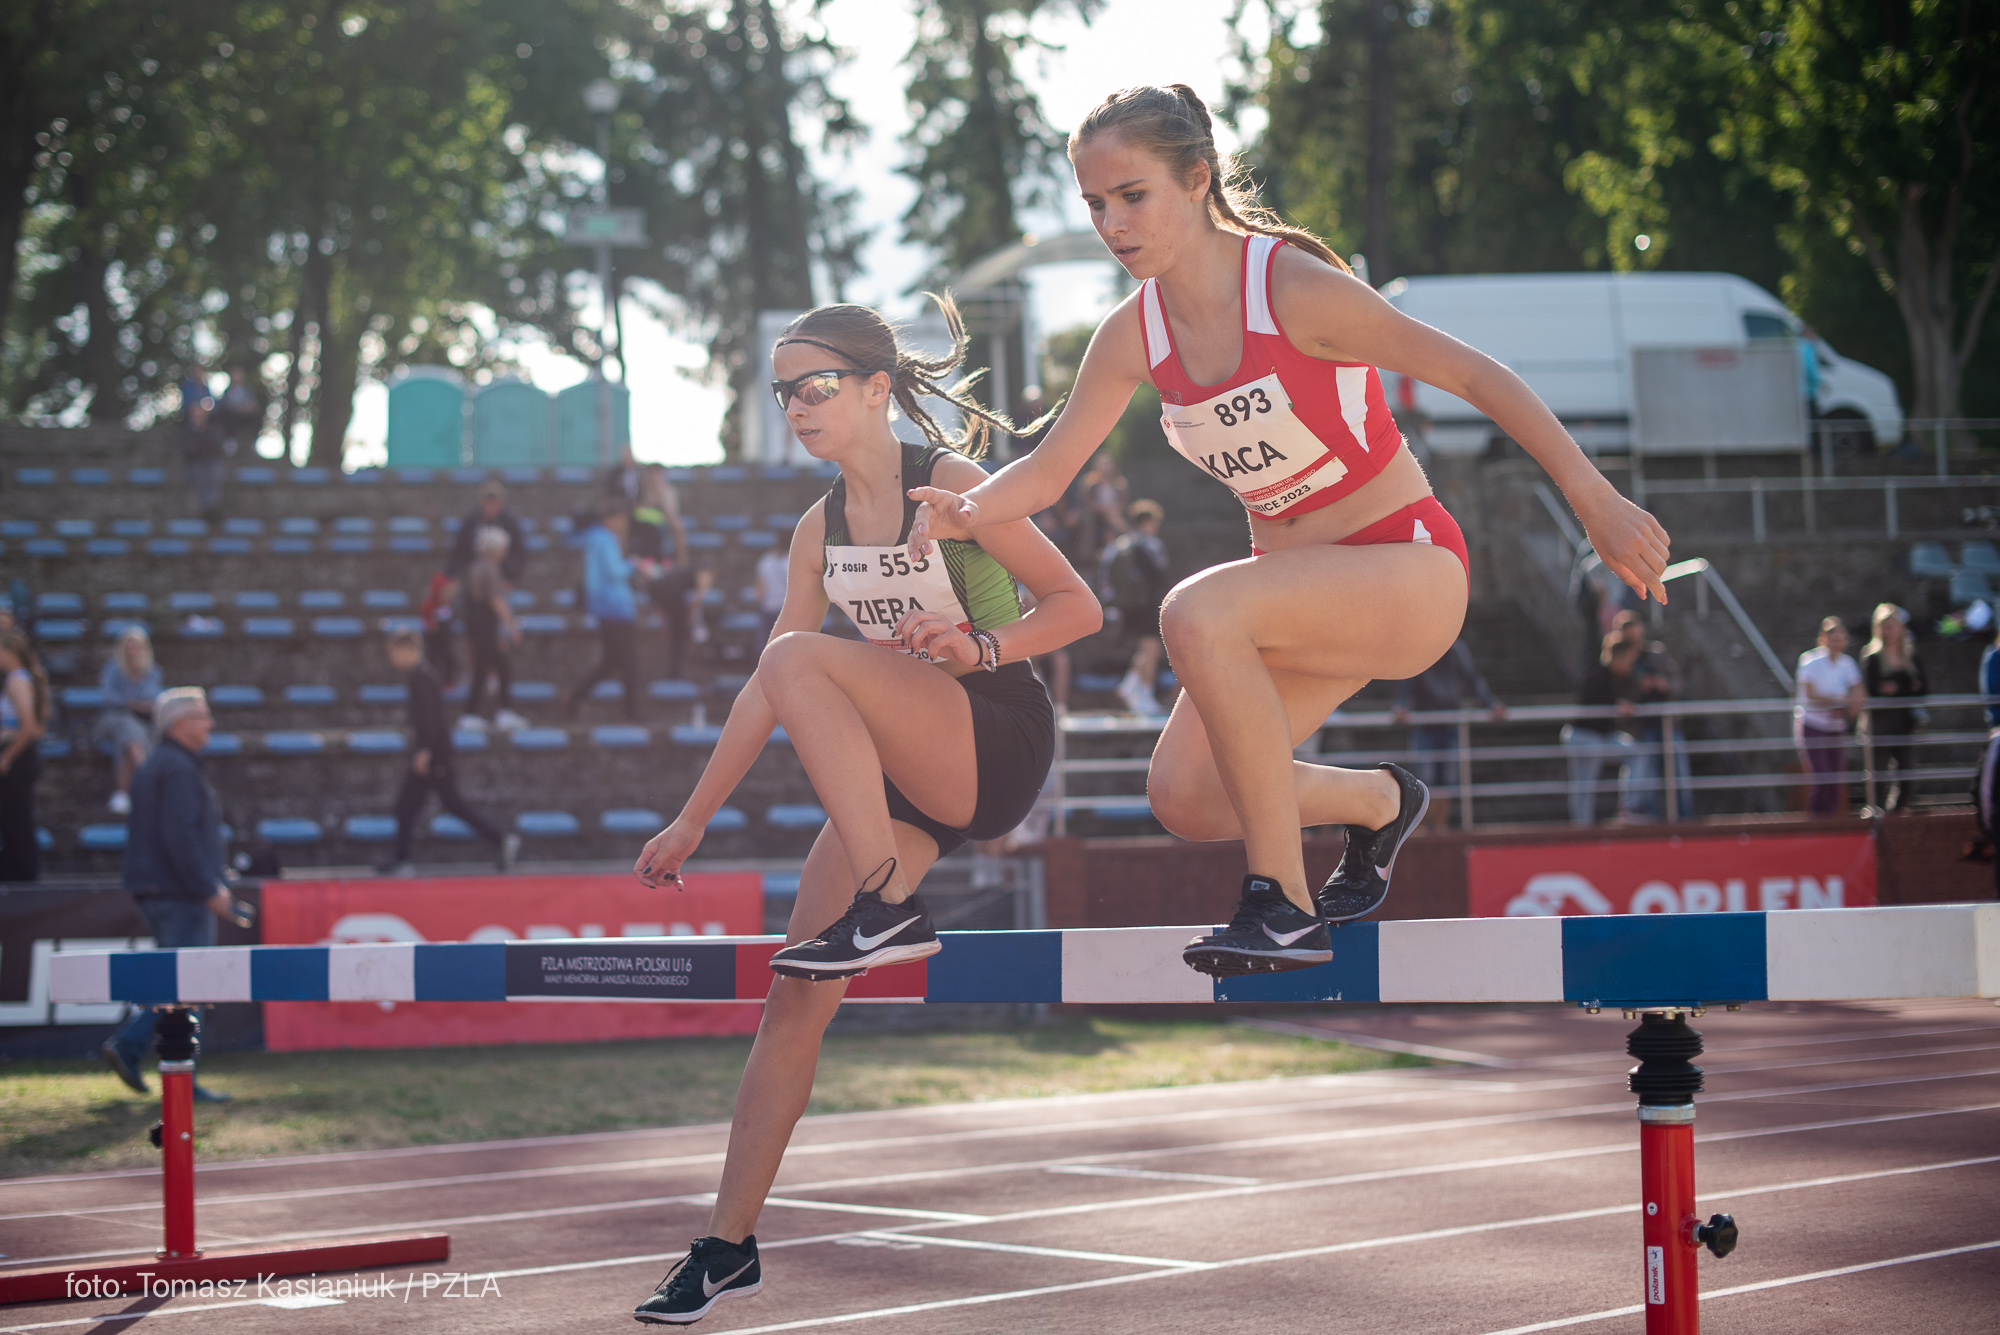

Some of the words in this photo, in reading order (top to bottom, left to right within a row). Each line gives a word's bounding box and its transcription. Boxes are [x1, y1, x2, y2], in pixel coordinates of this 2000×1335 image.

[1214, 388, 1272, 427] 893
[1199, 440, 1288, 479] KACA
[1280, 484, 1312, 504] 2023
[879, 548, 930, 578] 553
[541, 956, 565, 971] PZLA
[566, 956, 634, 972] MISTRZOSTWA
[635, 957, 670, 972] POLSKI
[672, 957, 693, 973] U16
[600, 974, 631, 985] JANUSZA
[1651, 1265, 1661, 1302] polanik
